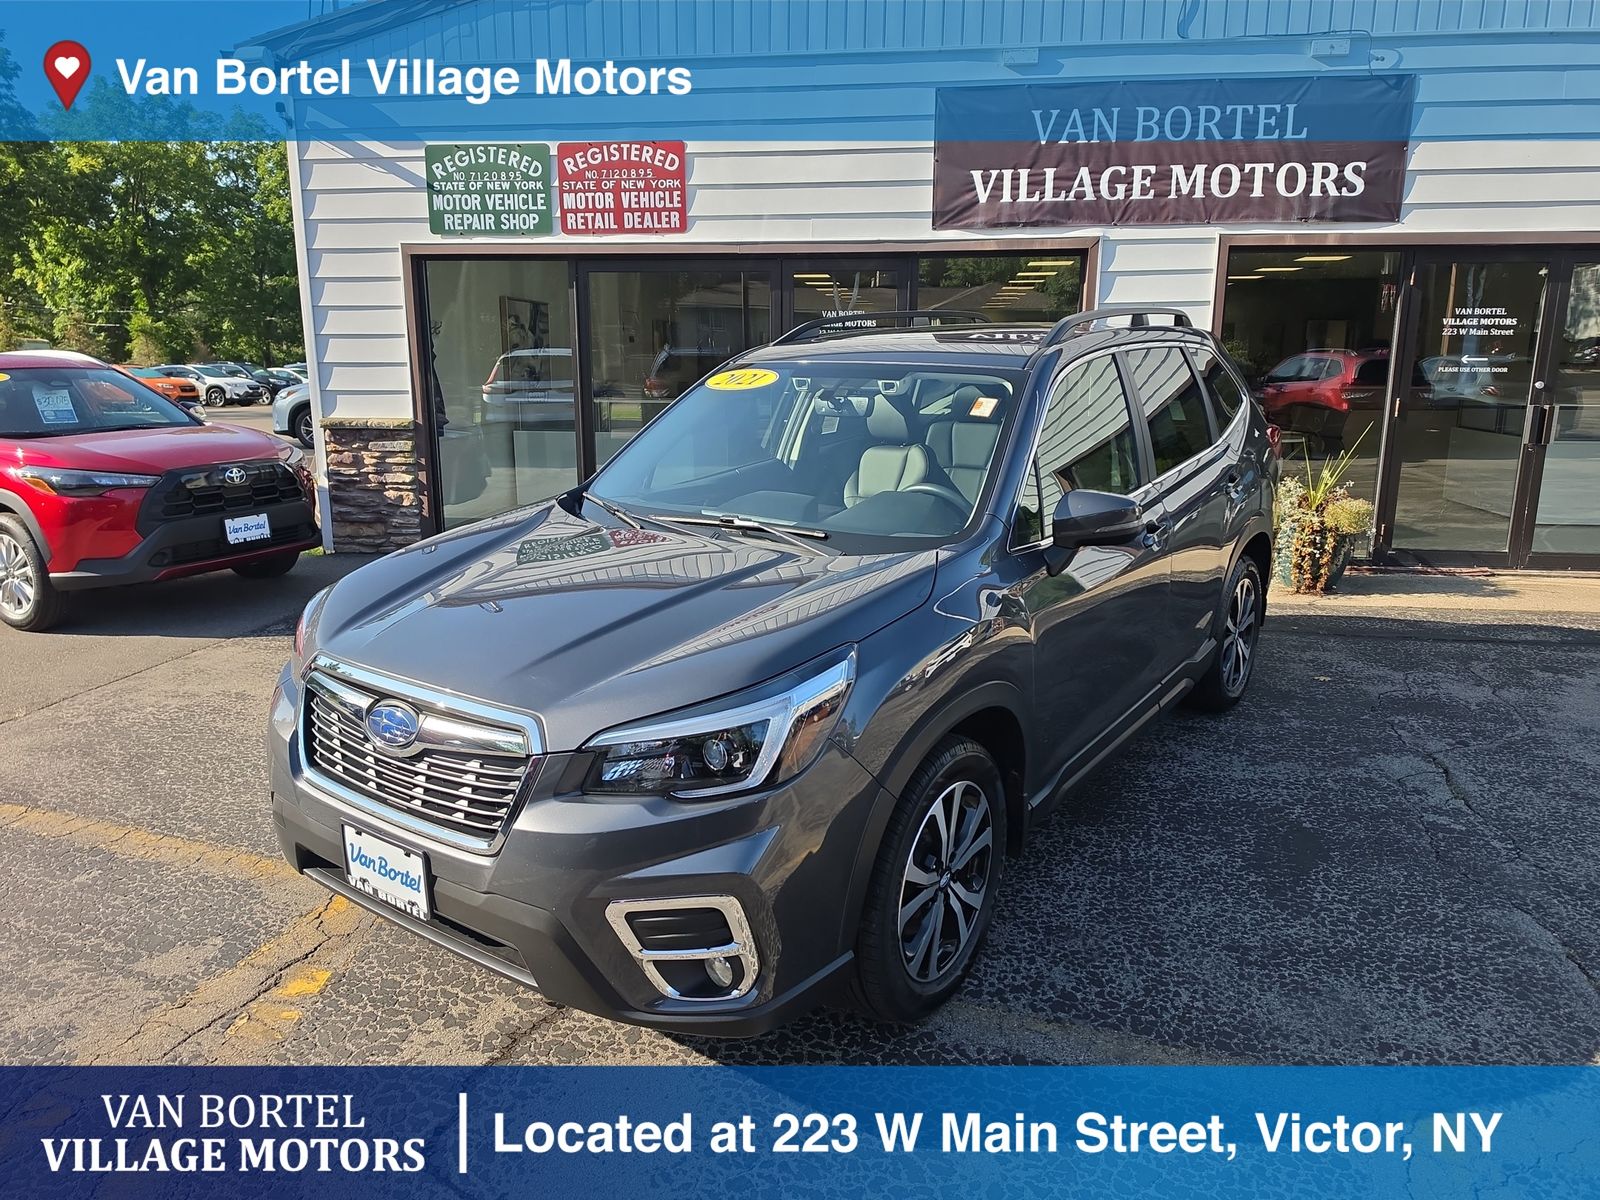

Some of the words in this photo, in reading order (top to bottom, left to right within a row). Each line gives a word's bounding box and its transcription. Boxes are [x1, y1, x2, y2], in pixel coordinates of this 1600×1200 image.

[1032, 107, 1120, 144] VAN
[1135, 103, 1308, 141] BORTEL
[432, 146, 543, 179] REGISTERED
[562, 143, 681, 176] REGISTERED
[453, 171, 467, 181] NO.
[469, 170, 522, 181] 7120895
[585, 170, 599, 180] NO.
[601, 168, 653, 178] 7120895
[433, 181, 464, 191] STATE
[468, 181, 483, 191] OF
[486, 180, 510, 191] NEW
[513, 180, 544, 190] YORK
[562, 180, 596, 190] STATE
[601, 180, 617, 190] OF
[621, 179, 646, 190] NEW
[650, 178, 682, 189] YORK
[969, 163, 1157, 204] VILLAGE
[1167, 160, 1368, 200] MOTORS
[433, 195, 481, 211] MOTOR
[485, 193, 547, 210] VEHICLE
[563, 192, 614, 209] MOTOR
[621, 190, 682, 208] VEHICLE
[444, 213, 496, 231] REPAIR
[500, 212, 540, 230] SHOP
[566, 211, 618, 230] RETAIL
[624, 211, 680, 229] DEALER
[821, 310, 837, 318] VAN
[1455, 307, 1473, 316] VAN
[1474, 307, 1508, 316] BORTEL
[1442, 317, 1479, 326] VILLAGE
[1480, 317, 1518, 326] MOTORS
[1442, 328, 1457, 336] 223
[1459, 328, 1468, 336] W
[1469, 328, 1488, 336] Main
[1490, 328, 1514, 336] Street
[713, 374, 768, 385] 2021
[349, 843, 376, 872] Van
[378, 856, 421, 893] Bortel
